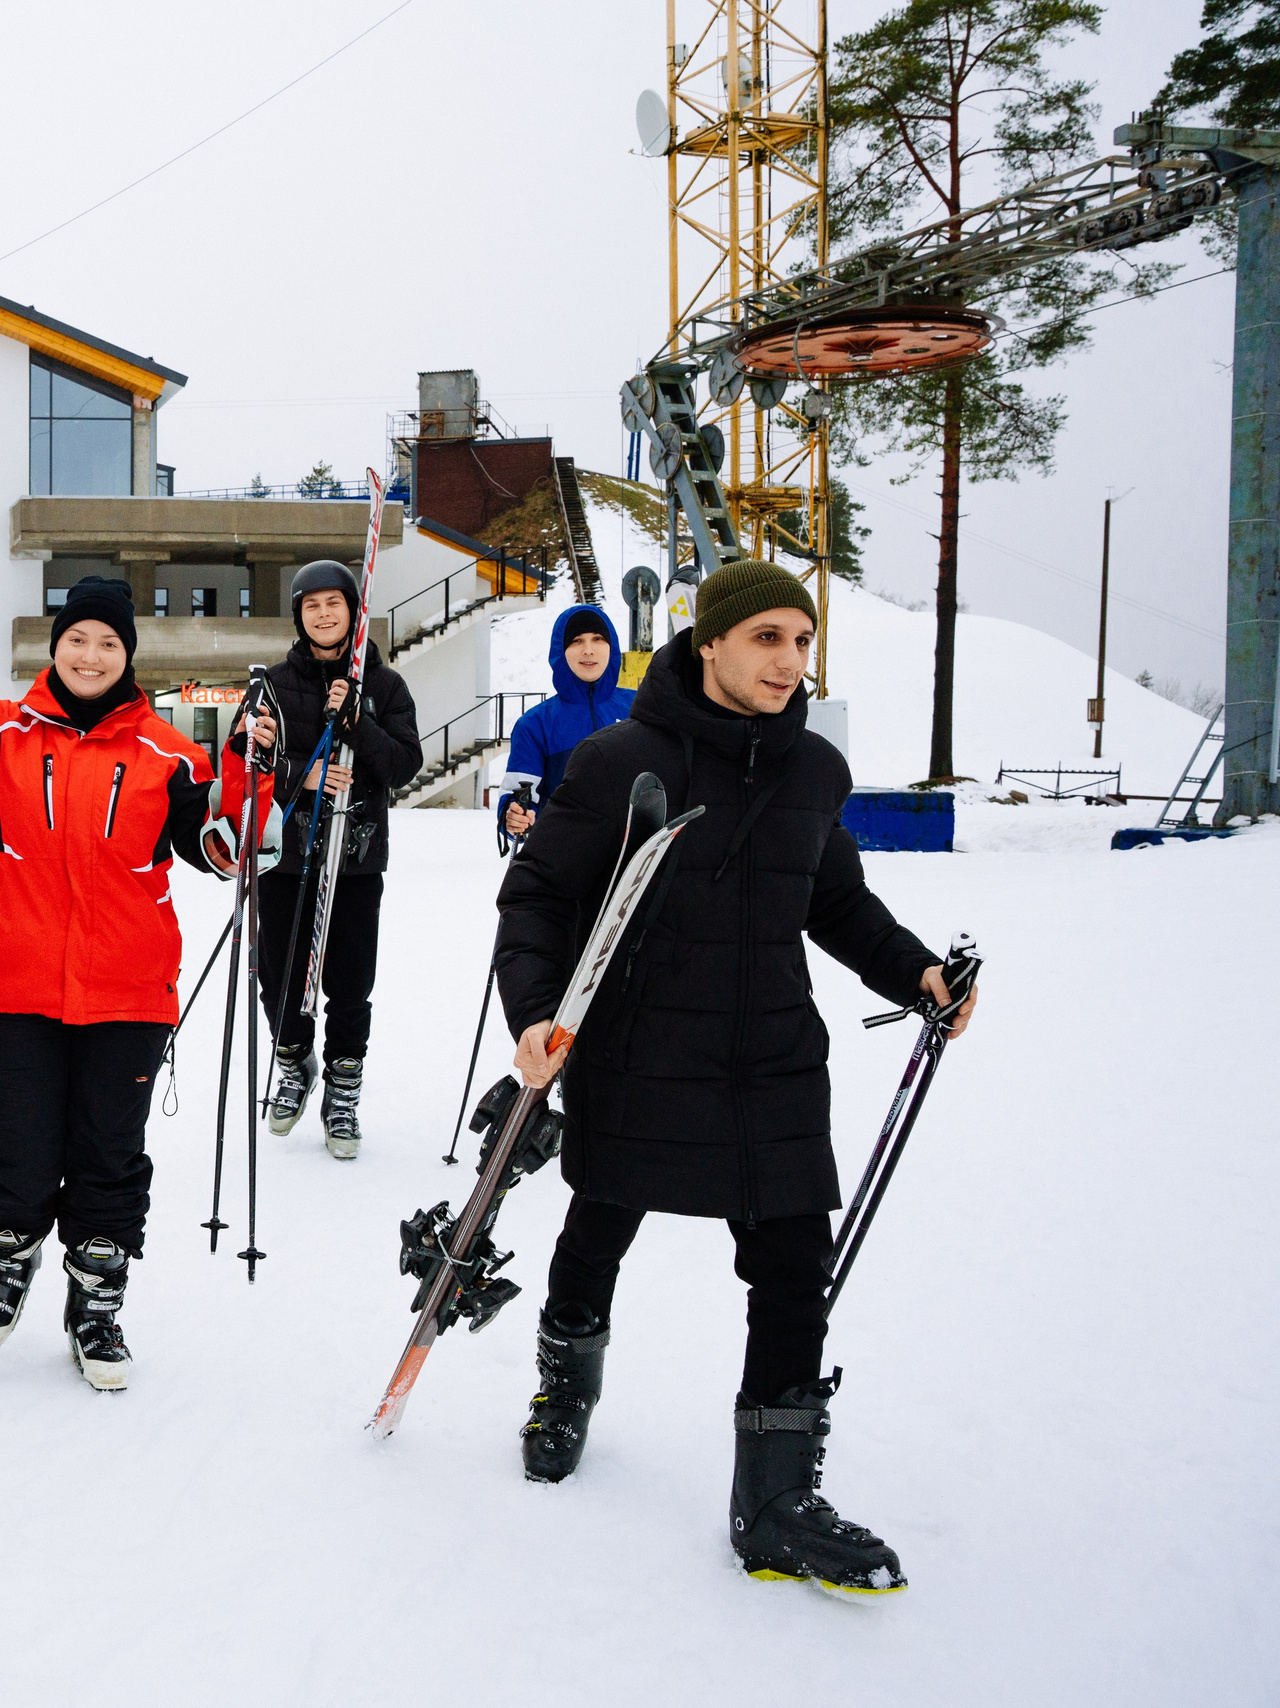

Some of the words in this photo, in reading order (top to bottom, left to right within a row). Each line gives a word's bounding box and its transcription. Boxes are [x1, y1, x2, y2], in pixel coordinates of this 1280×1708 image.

[244, 736, 254, 773] masters
[581, 848, 658, 996] HEAD
[911, 1020, 934, 1061] masters
[538, 1328, 568, 1347] CHER
